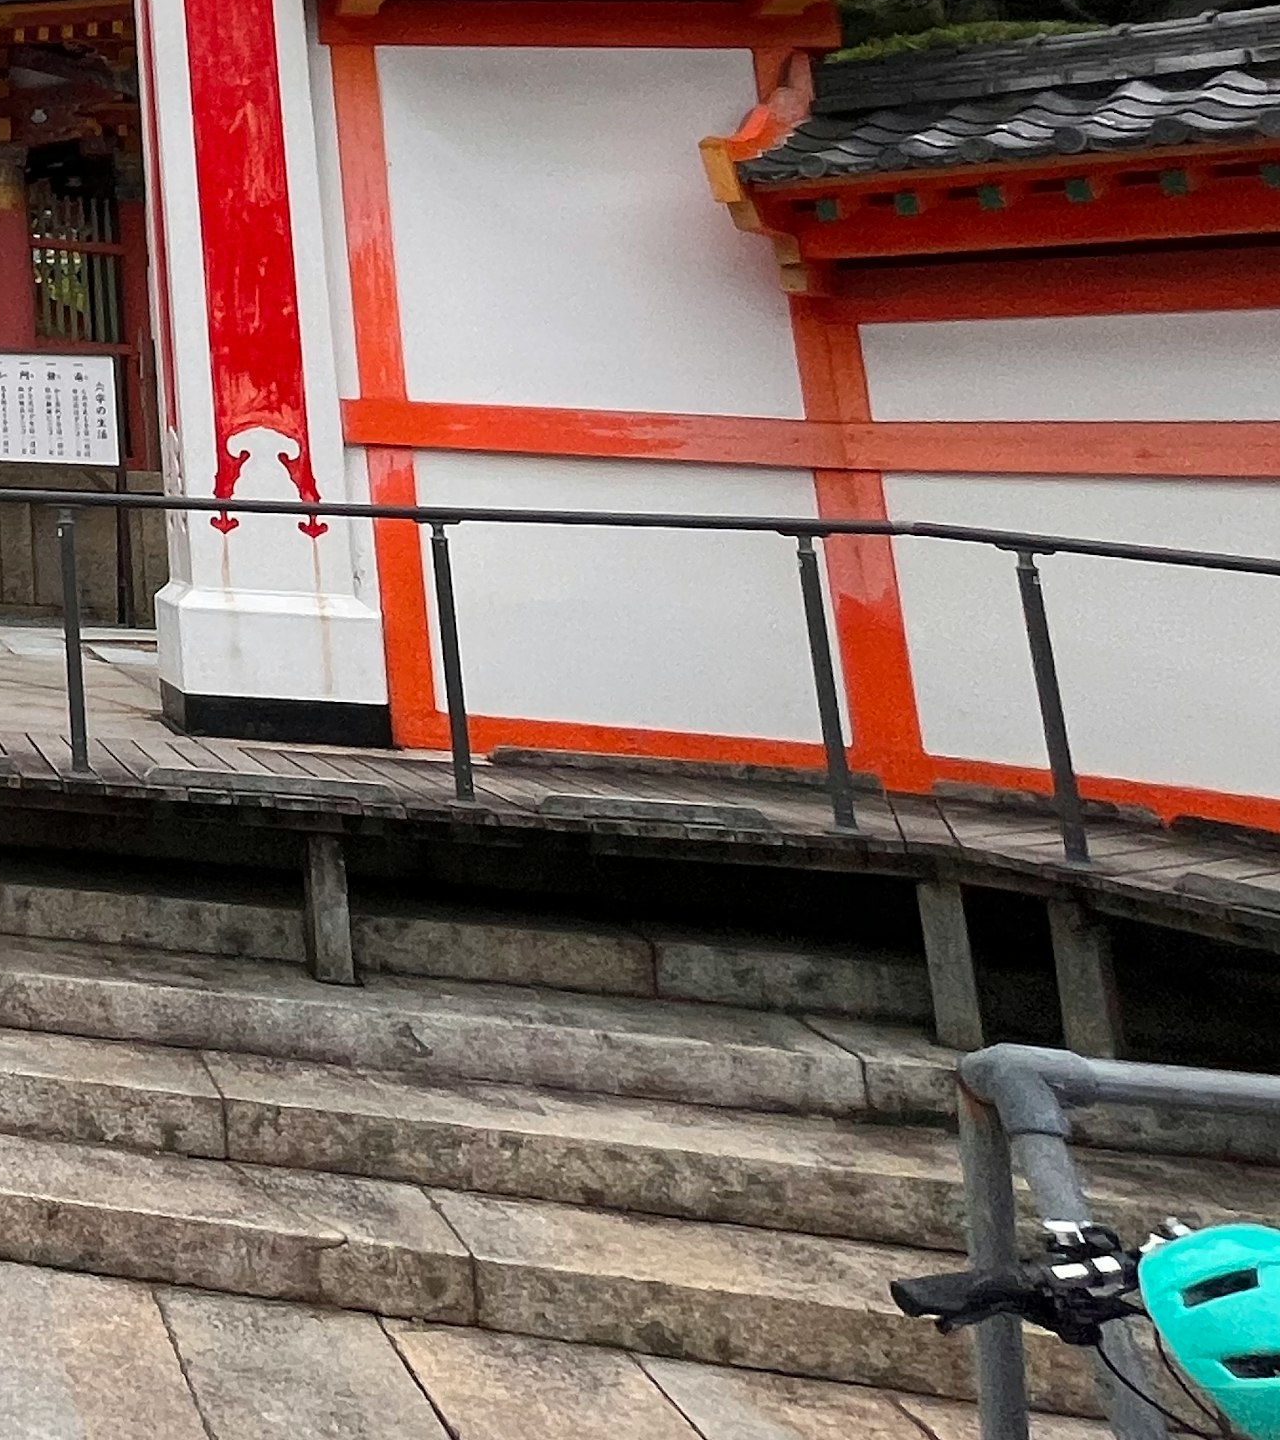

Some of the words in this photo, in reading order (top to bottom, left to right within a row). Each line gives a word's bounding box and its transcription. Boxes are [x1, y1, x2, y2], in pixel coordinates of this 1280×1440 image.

[95, 381, 108, 439] 六字の生活
